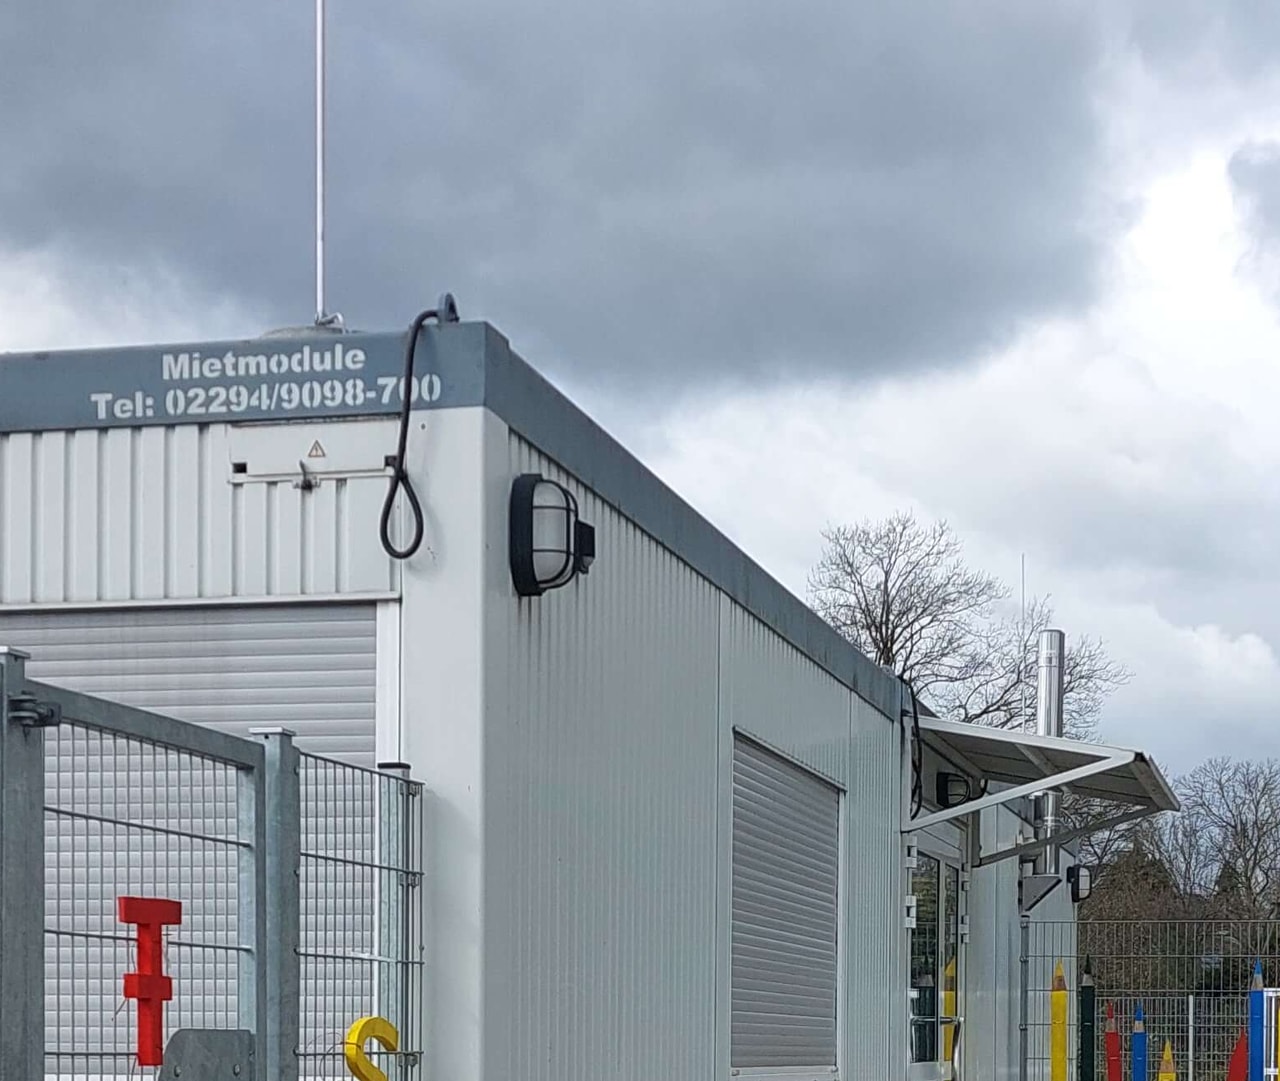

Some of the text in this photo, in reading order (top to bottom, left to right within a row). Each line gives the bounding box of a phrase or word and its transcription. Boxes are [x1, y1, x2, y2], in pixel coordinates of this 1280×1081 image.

[162, 343, 366, 380] Mietmodule
[90, 373, 441, 419] Tel: 02294/9098-700
